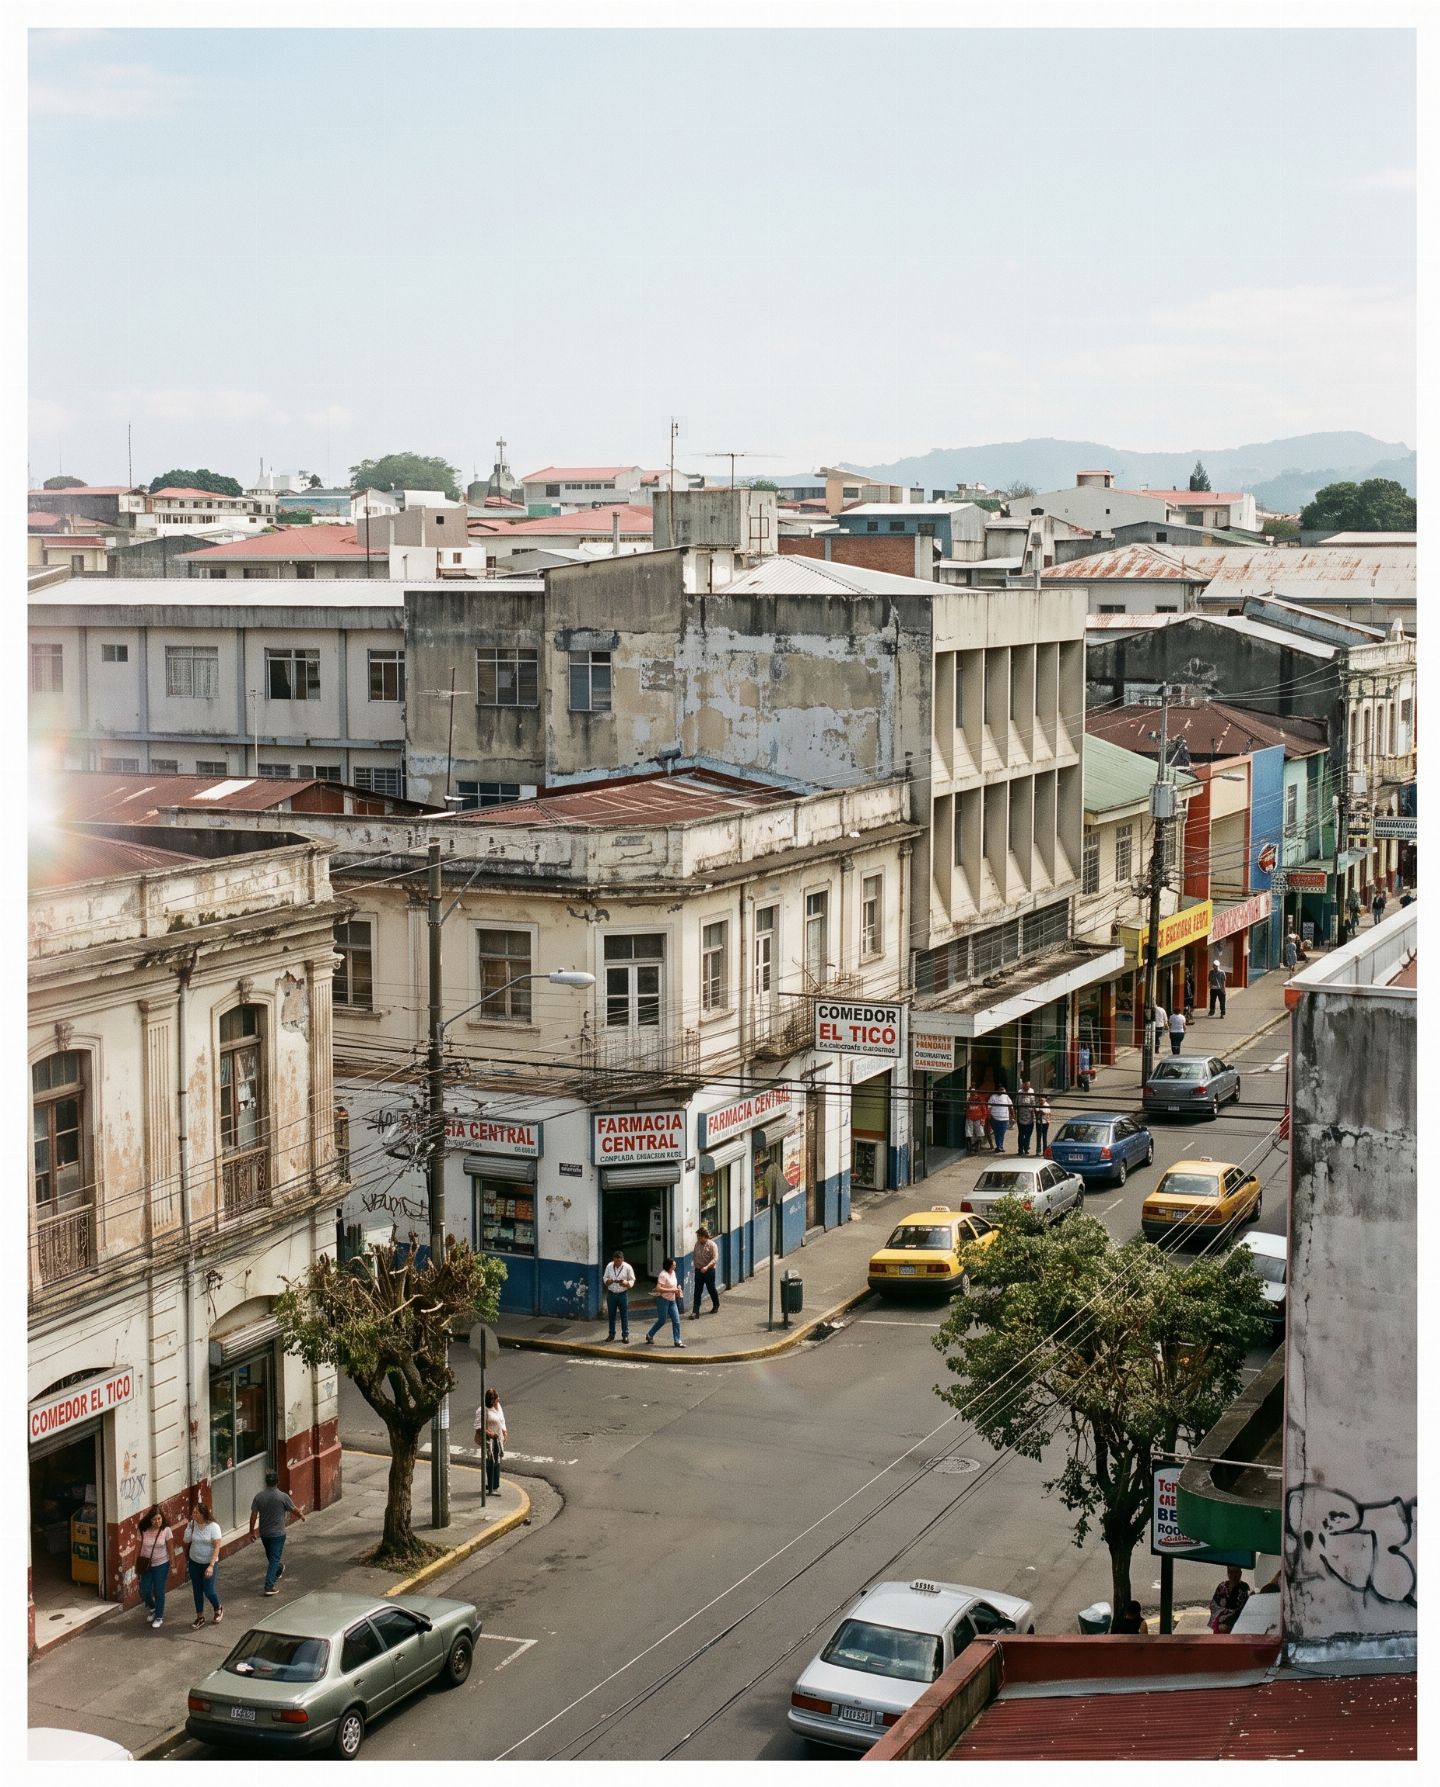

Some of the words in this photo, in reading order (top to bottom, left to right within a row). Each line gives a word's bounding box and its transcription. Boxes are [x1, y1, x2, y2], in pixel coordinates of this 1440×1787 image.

[818, 1005, 897, 1024] COMEDOR
[819, 1023, 843, 1041] EL
[708, 1100, 753, 1136] FARMACIA
[754, 1083, 790, 1115] CENTRAL
[469, 1121, 535, 1146] CENTRAL
[597, 1113, 683, 1135] FARMACIA
[601, 1133, 679, 1153] CENTRAL
[31, 1393, 88, 1437] COMEDOR
[90, 1387, 104, 1412] EL
[106, 1375, 130, 1405] TICO
[1157, 1507, 1178, 1523] BE
